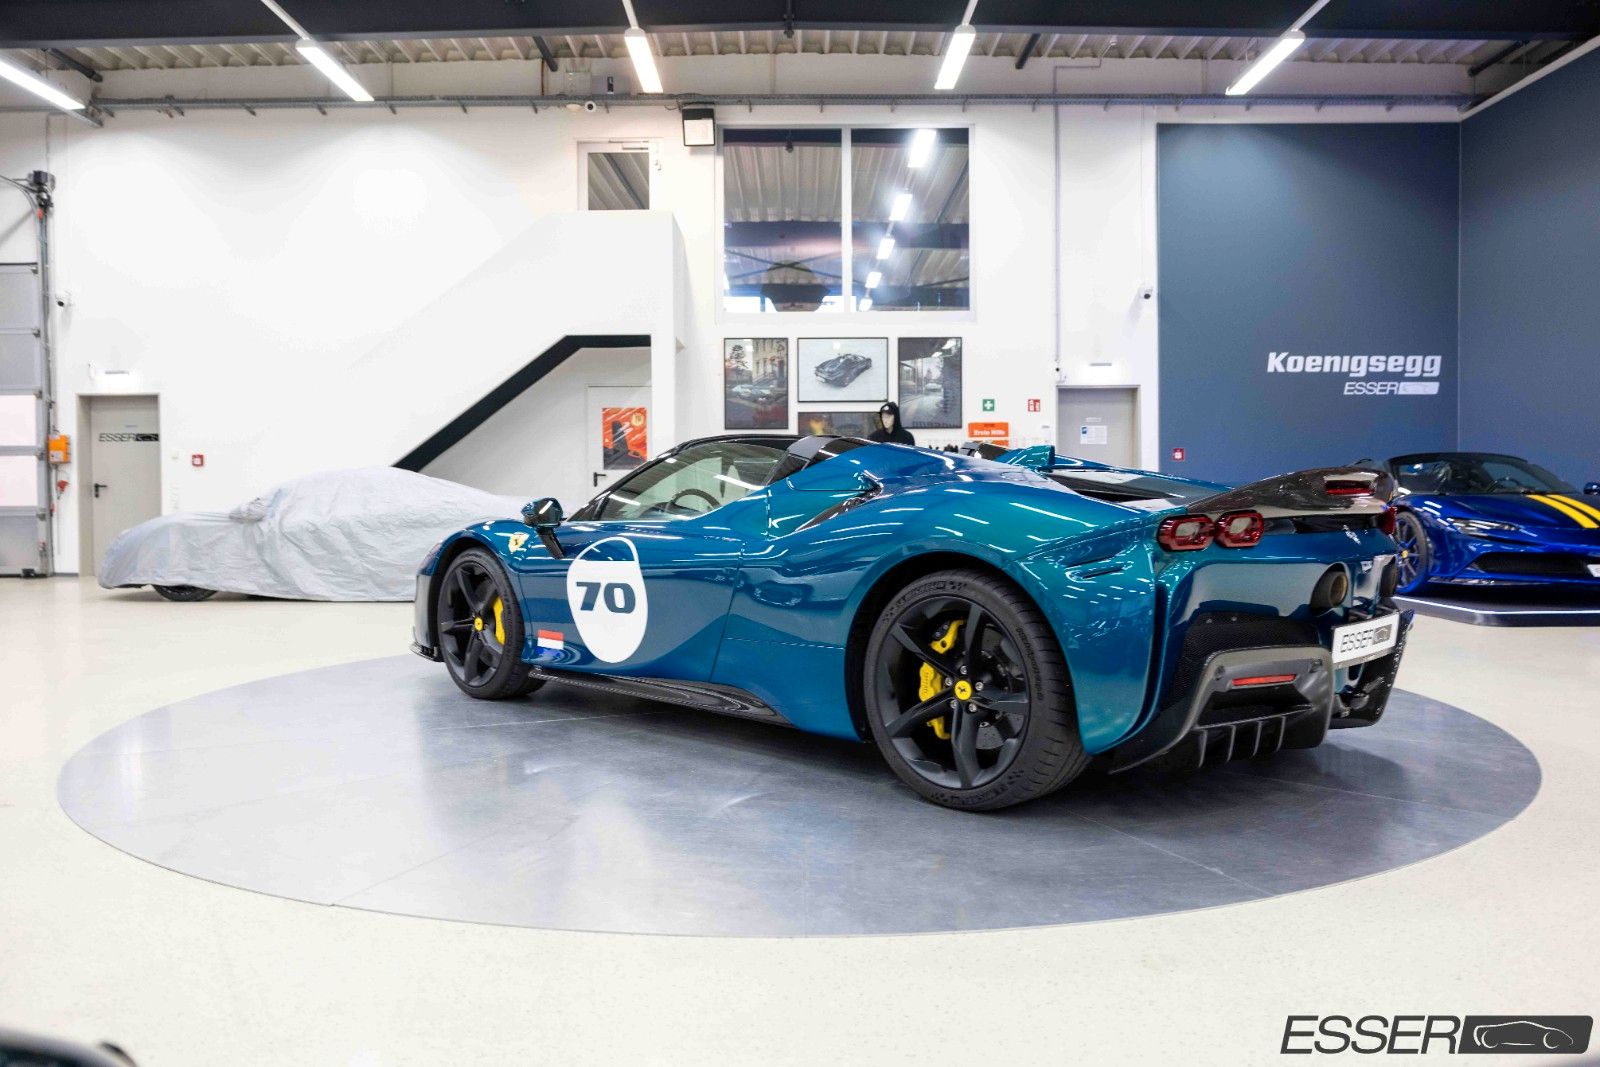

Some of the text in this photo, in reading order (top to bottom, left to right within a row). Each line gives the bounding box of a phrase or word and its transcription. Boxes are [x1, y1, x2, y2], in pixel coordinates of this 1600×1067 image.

[1267, 352, 1442, 377] Koenigsegg
[1344, 381, 1399, 395] ESSER
[98, 432, 137, 442] ESSER
[576, 581, 636, 614] 70
[1340, 629, 1375, 653] ESSER
